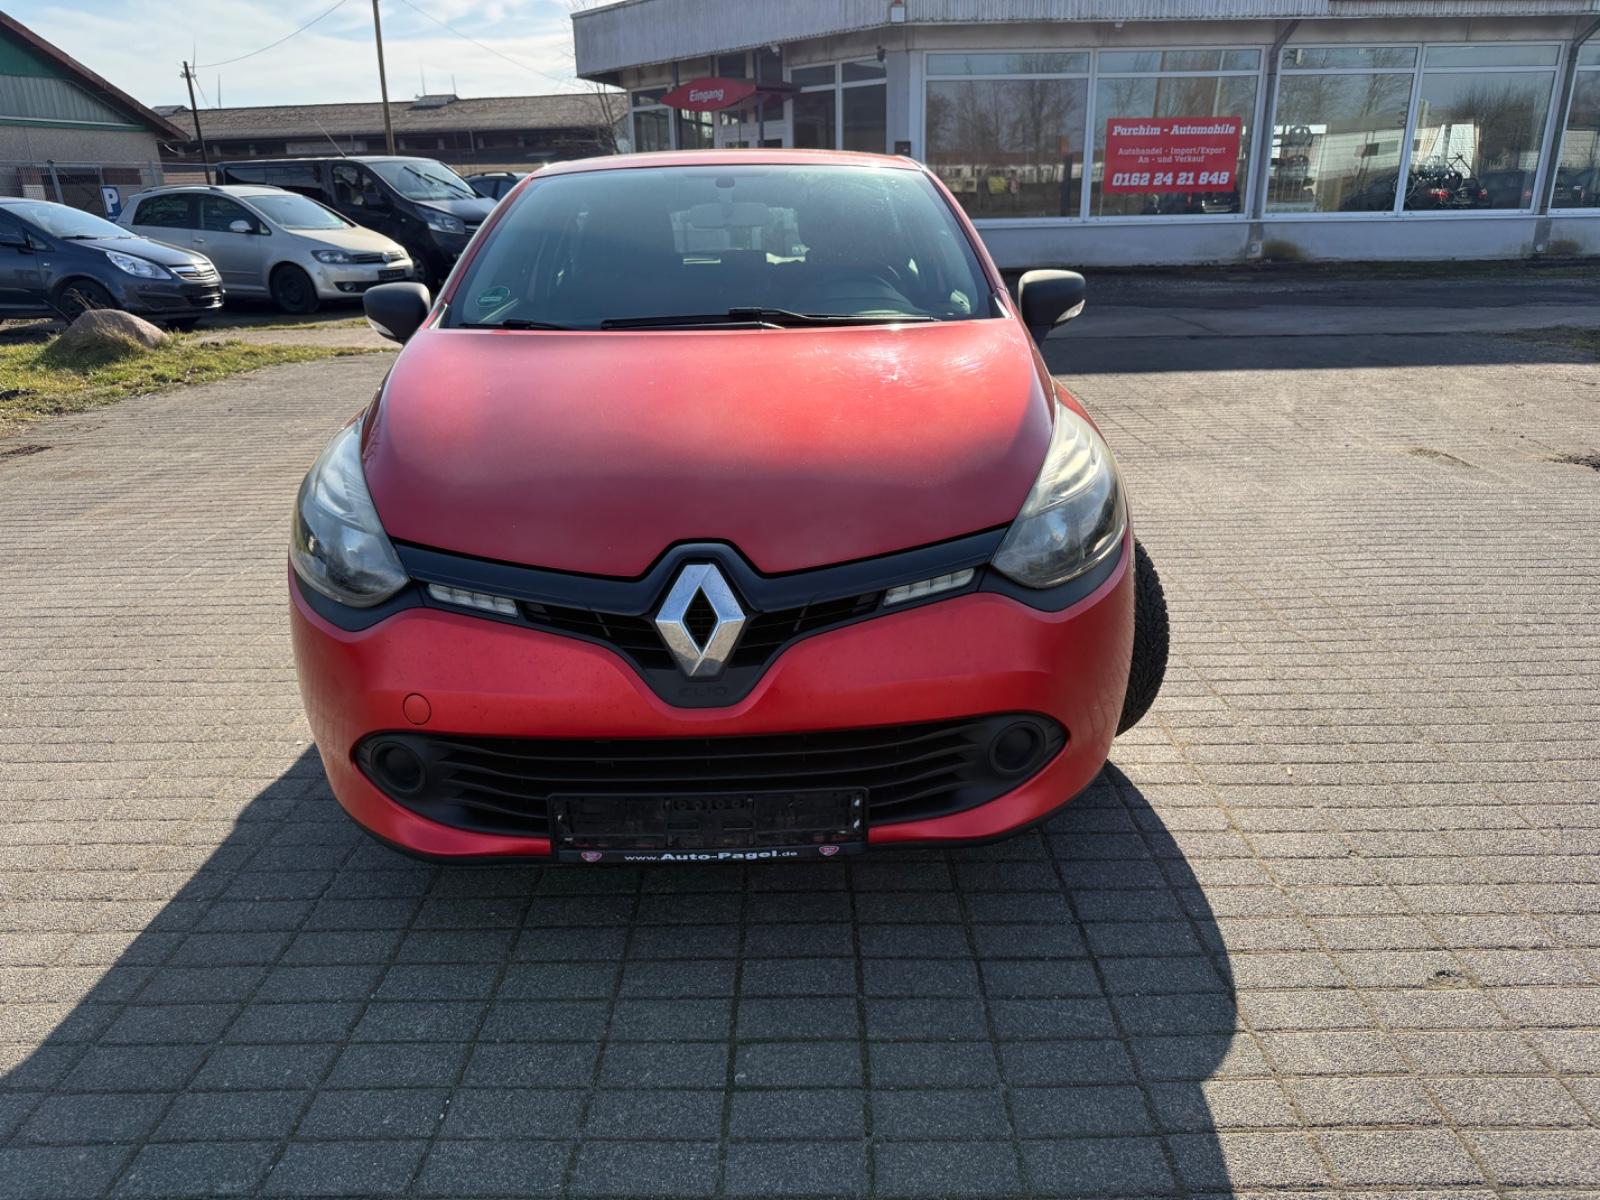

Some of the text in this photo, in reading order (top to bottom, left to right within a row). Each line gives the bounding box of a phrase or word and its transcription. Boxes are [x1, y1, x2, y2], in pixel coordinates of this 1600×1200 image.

[689, 88, 725, 102] Eingang
[1112, 125, 1161, 136] Parchim
[1170, 124, 1236, 135] Automobile
[1118, 147, 1163, 155] Autohandel
[1170, 146, 1226, 155] Import/Export
[1158, 155, 1172, 163] und
[1175, 155, 1205, 163] Verkauf
[1112, 171, 1230, 186] 0162 24 21 848
[102, 188, 118, 213] P
[624, 850, 798, 861] www.Auto-Pagel.de
